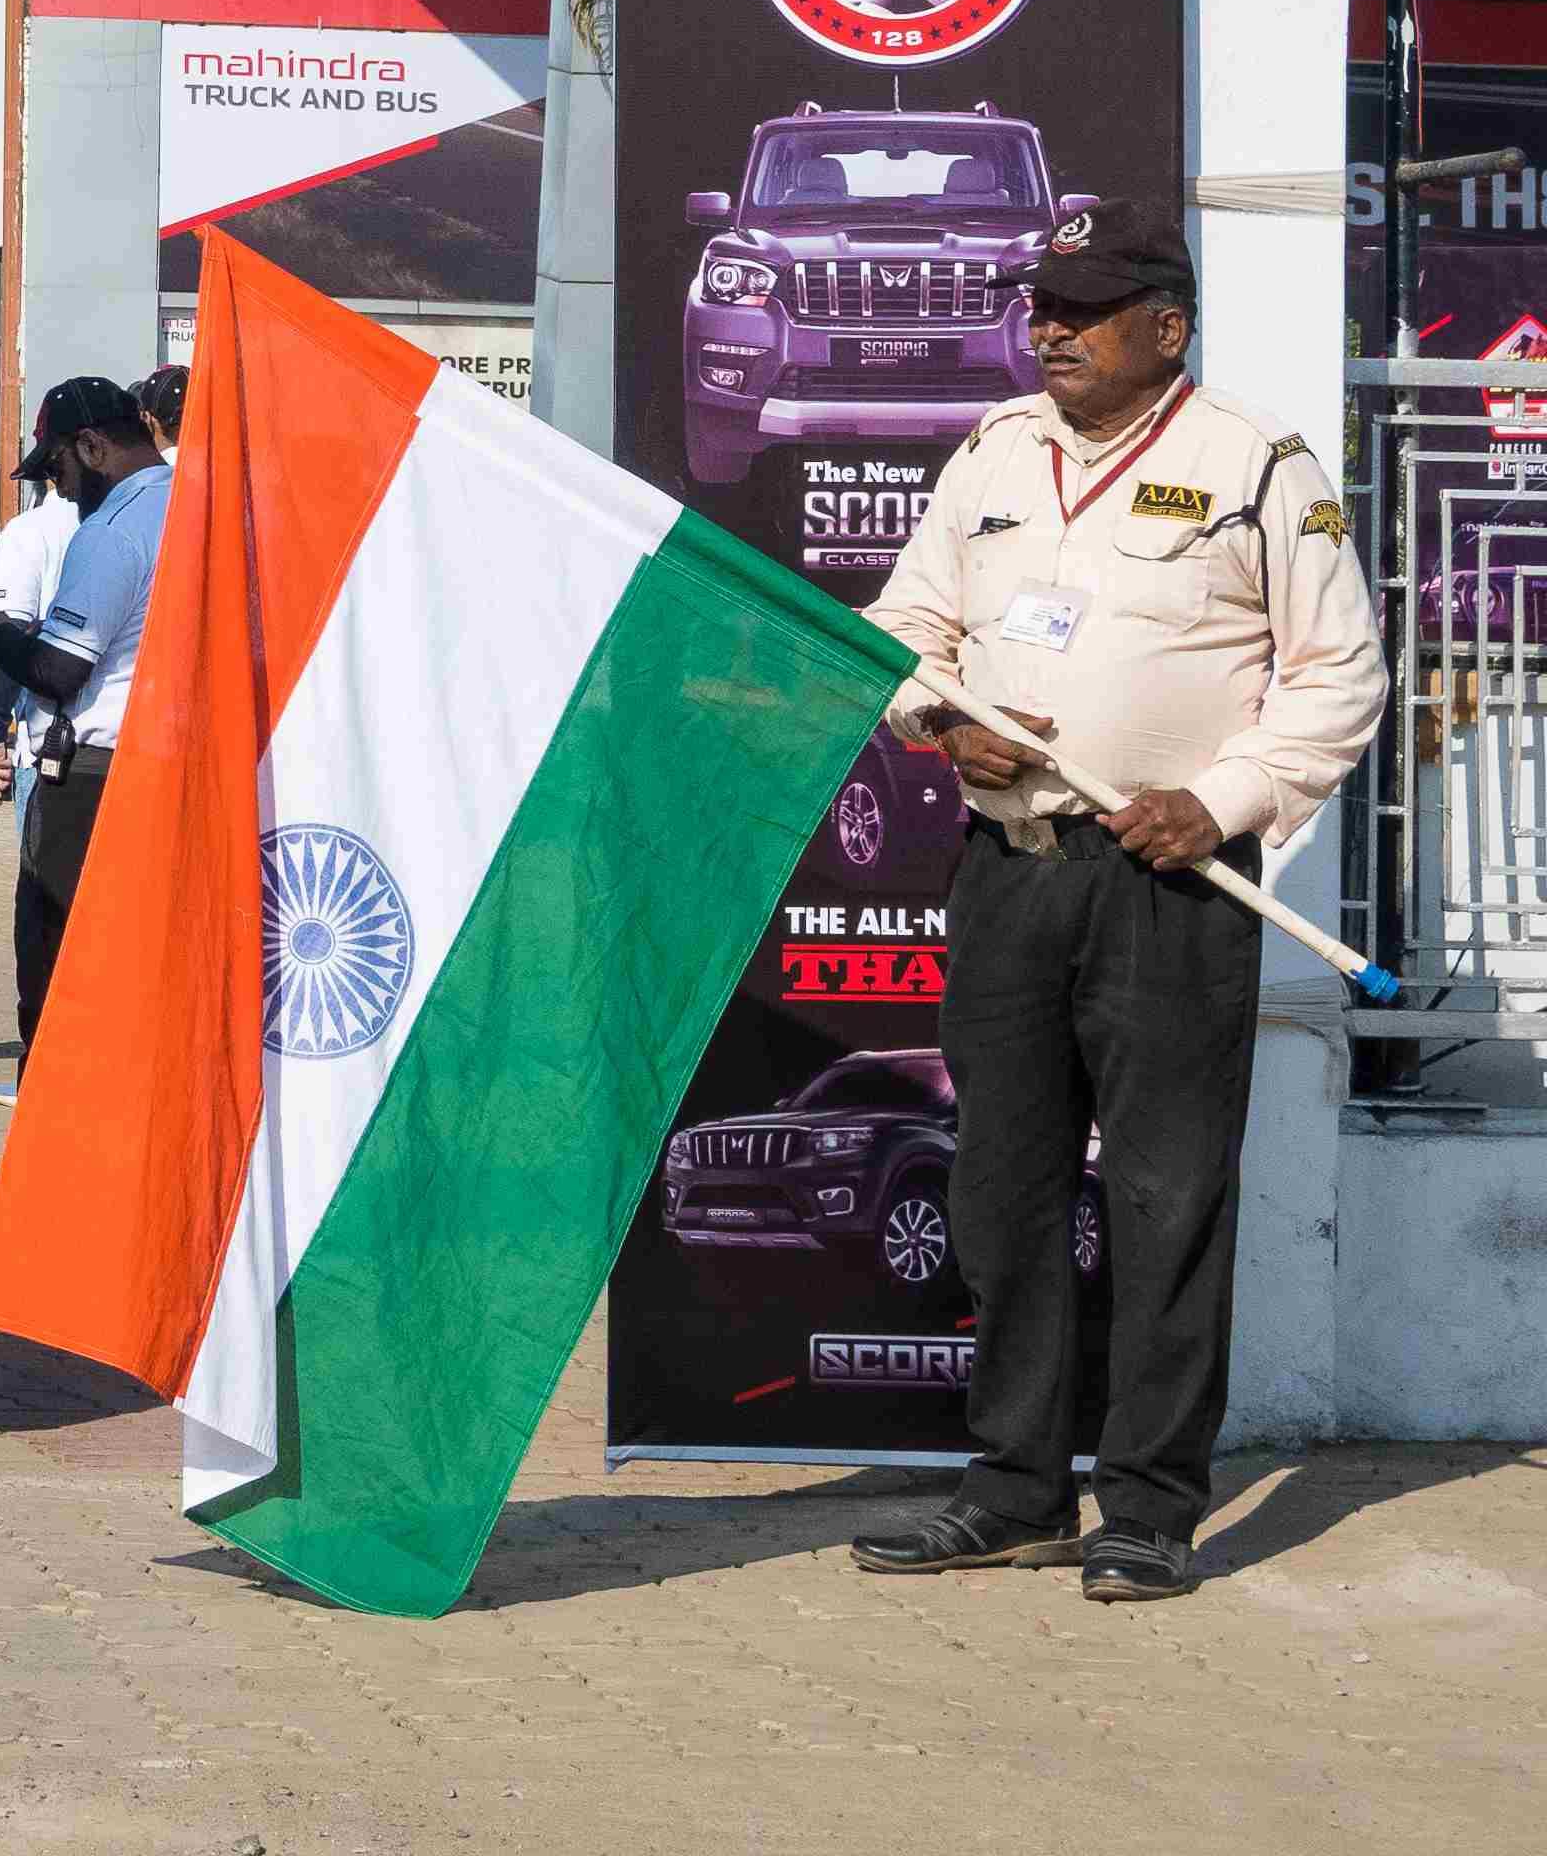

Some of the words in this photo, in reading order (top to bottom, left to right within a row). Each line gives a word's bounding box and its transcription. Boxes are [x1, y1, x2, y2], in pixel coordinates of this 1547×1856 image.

[872, 30, 923, 47] 128
[184, 49, 406, 81] mahindra
[185, 84, 291, 109] TRUCK
[300, 88, 364, 111] AND
[376, 91, 438, 113] BUS
[803, 461, 856, 483] The
[863, 462, 925, 483] New
[1137, 484, 1205, 512] AJAX
[826, 554, 895, 566] CLASSI
[785, 907, 846, 935] THE
[857, 908, 947, 936] ALL-N
[782, 951, 946, 993] THA
